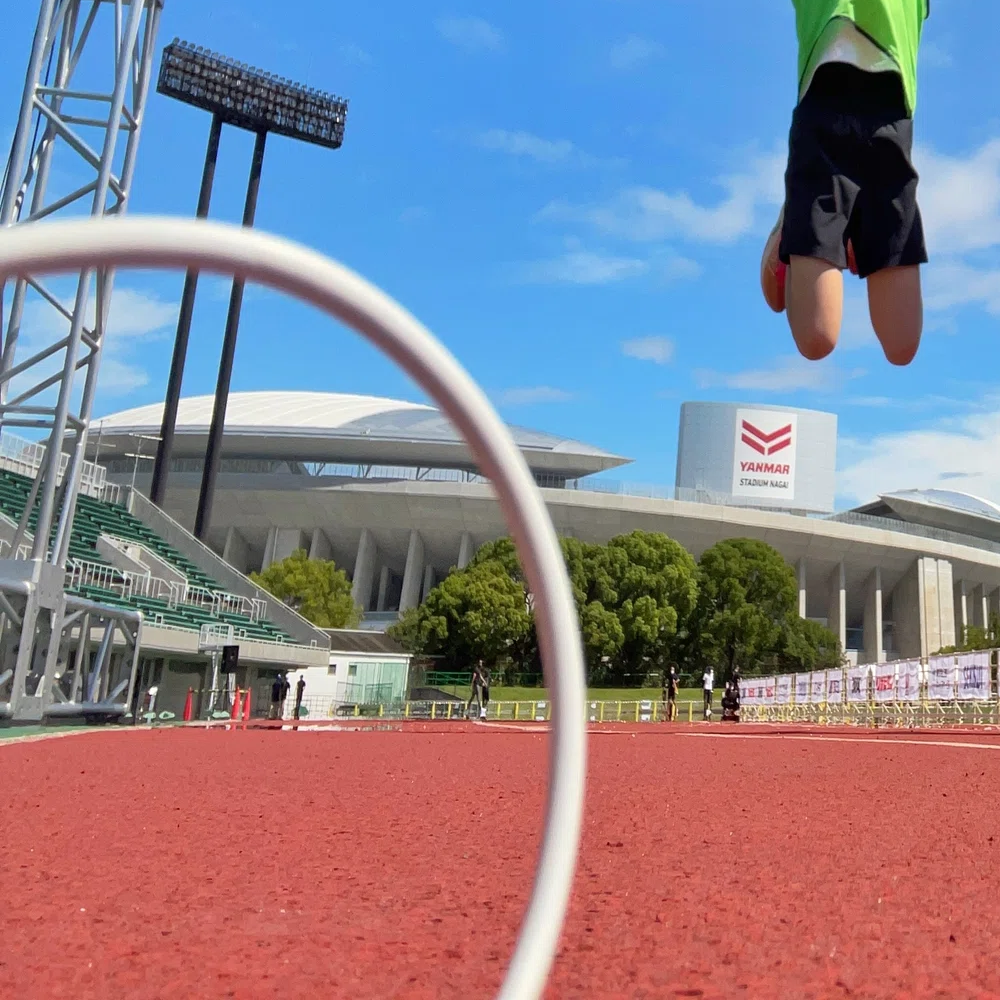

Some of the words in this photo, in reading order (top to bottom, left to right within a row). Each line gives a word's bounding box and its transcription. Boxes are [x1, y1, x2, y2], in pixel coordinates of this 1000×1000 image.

[740, 461, 790, 475] YANMAR
[739, 478, 768, 487] STADIUM
[770, 480, 789, 489] NAGAI
